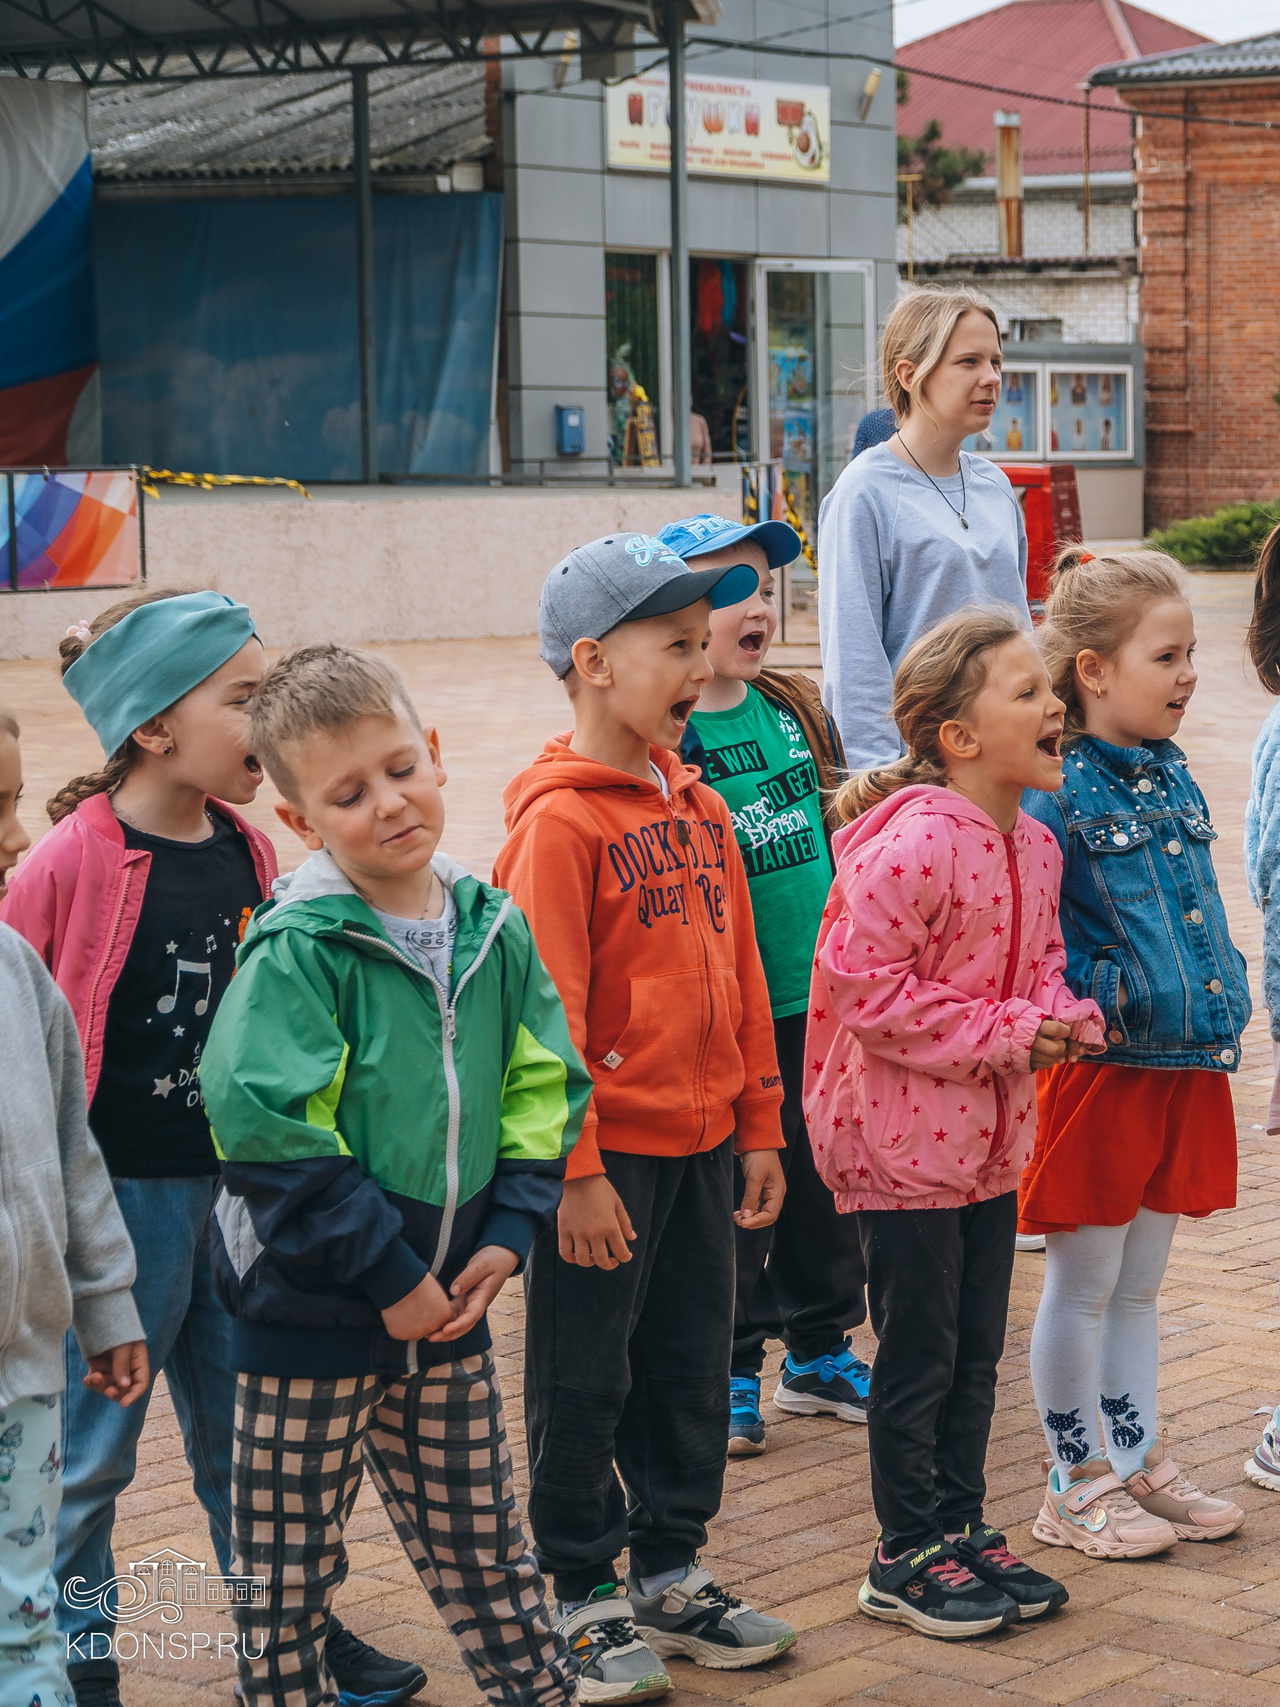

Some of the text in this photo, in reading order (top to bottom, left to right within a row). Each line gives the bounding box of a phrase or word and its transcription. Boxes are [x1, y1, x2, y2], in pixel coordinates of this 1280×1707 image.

[627, 91, 760, 143] ИГУШКИ
[716, 743, 762, 773] WAY
[760, 780, 788, 809] TO
[638, 884, 689, 929] Quay
